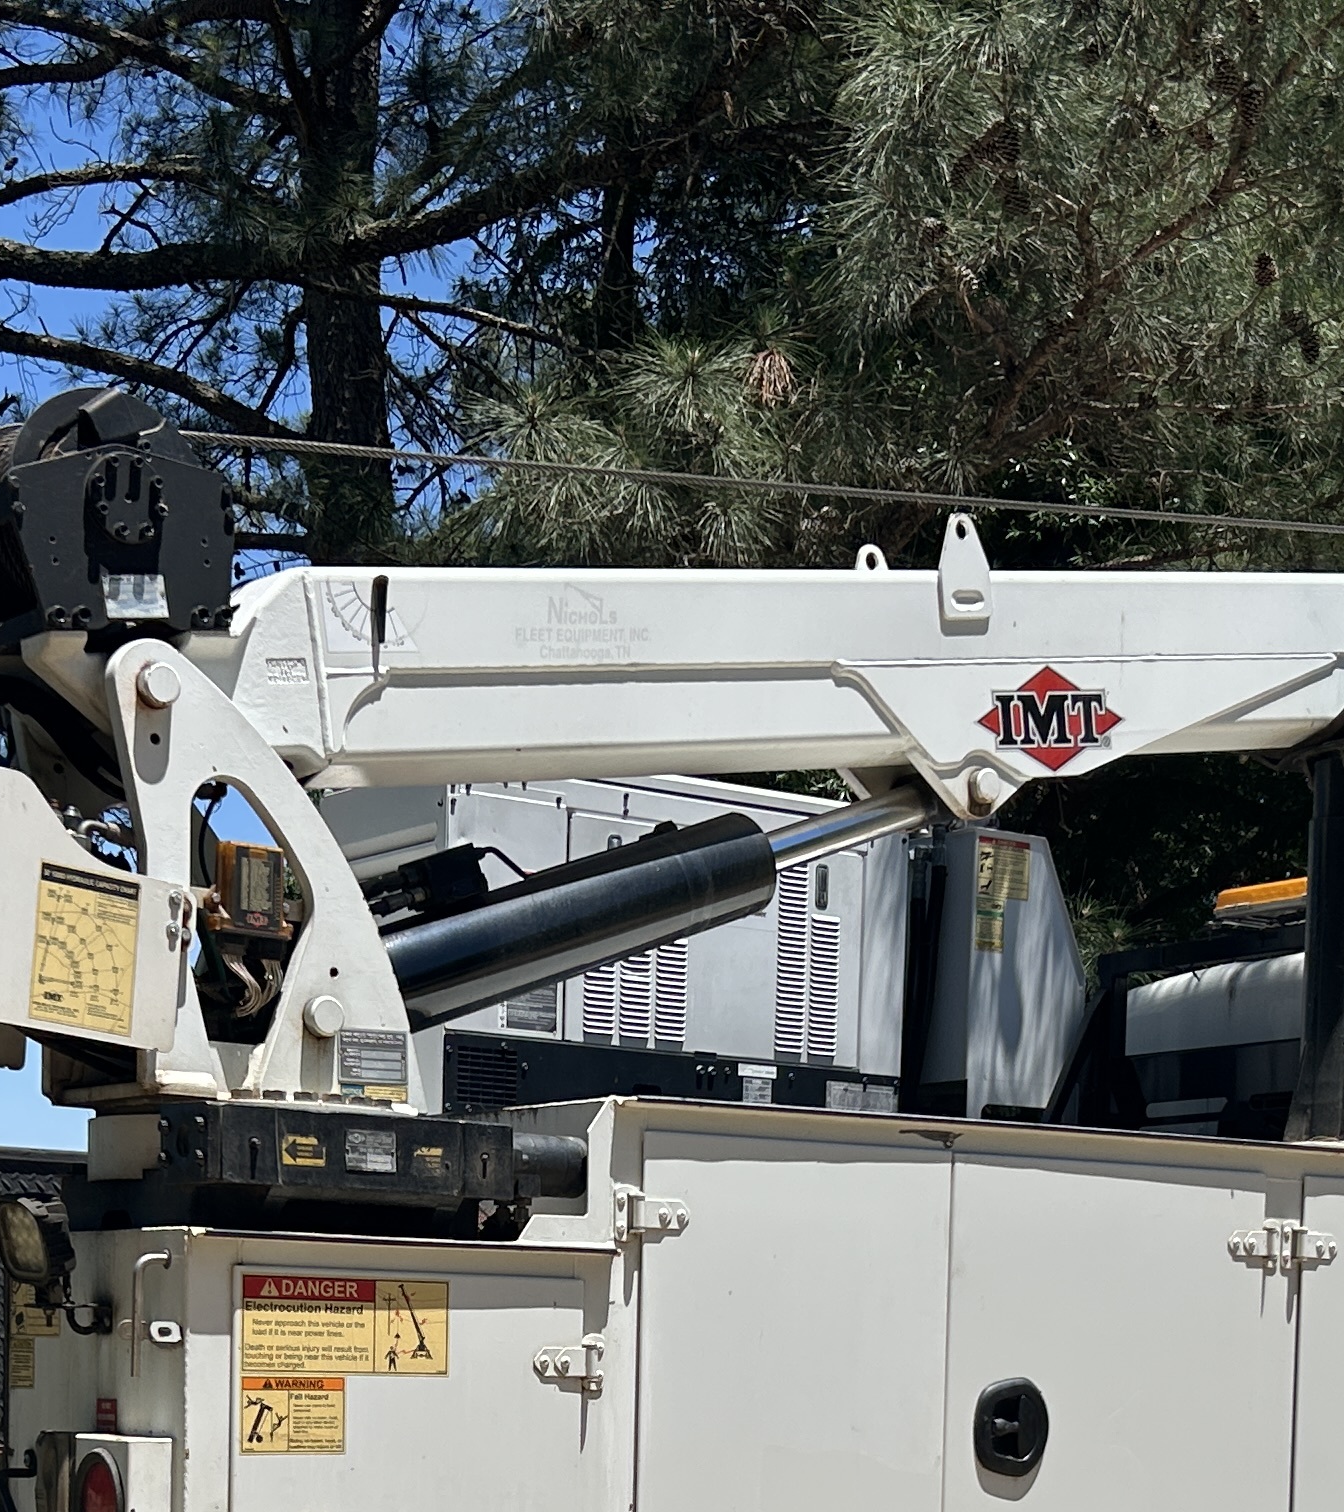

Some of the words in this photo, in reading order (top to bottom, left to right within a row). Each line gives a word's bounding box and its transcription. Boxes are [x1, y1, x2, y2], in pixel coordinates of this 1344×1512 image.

[515, 627, 553, 642] FLEET
[615, 645, 631, 659] TN
[993, 691, 1105, 748] IMT
[281, 1280, 358, 1298] DANGER
[244, 1300, 321, 1314] Electrocution
[324, 1303, 364, 1315] Hazard
[252, 1318, 273, 1326] Never
[274, 1319, 306, 1329] approach
[321, 1320, 345, 1328] vehicle
[304, 1330, 325, 1338] power
[244, 1343, 265, 1351] Death
[302, 1344, 320, 1353] injury
[334, 1345, 352, 1353] result
[244, 1353, 274, 1362] touching
[283, 1353, 303, 1362] being
[274, 1379, 325, 1389] WARNING
